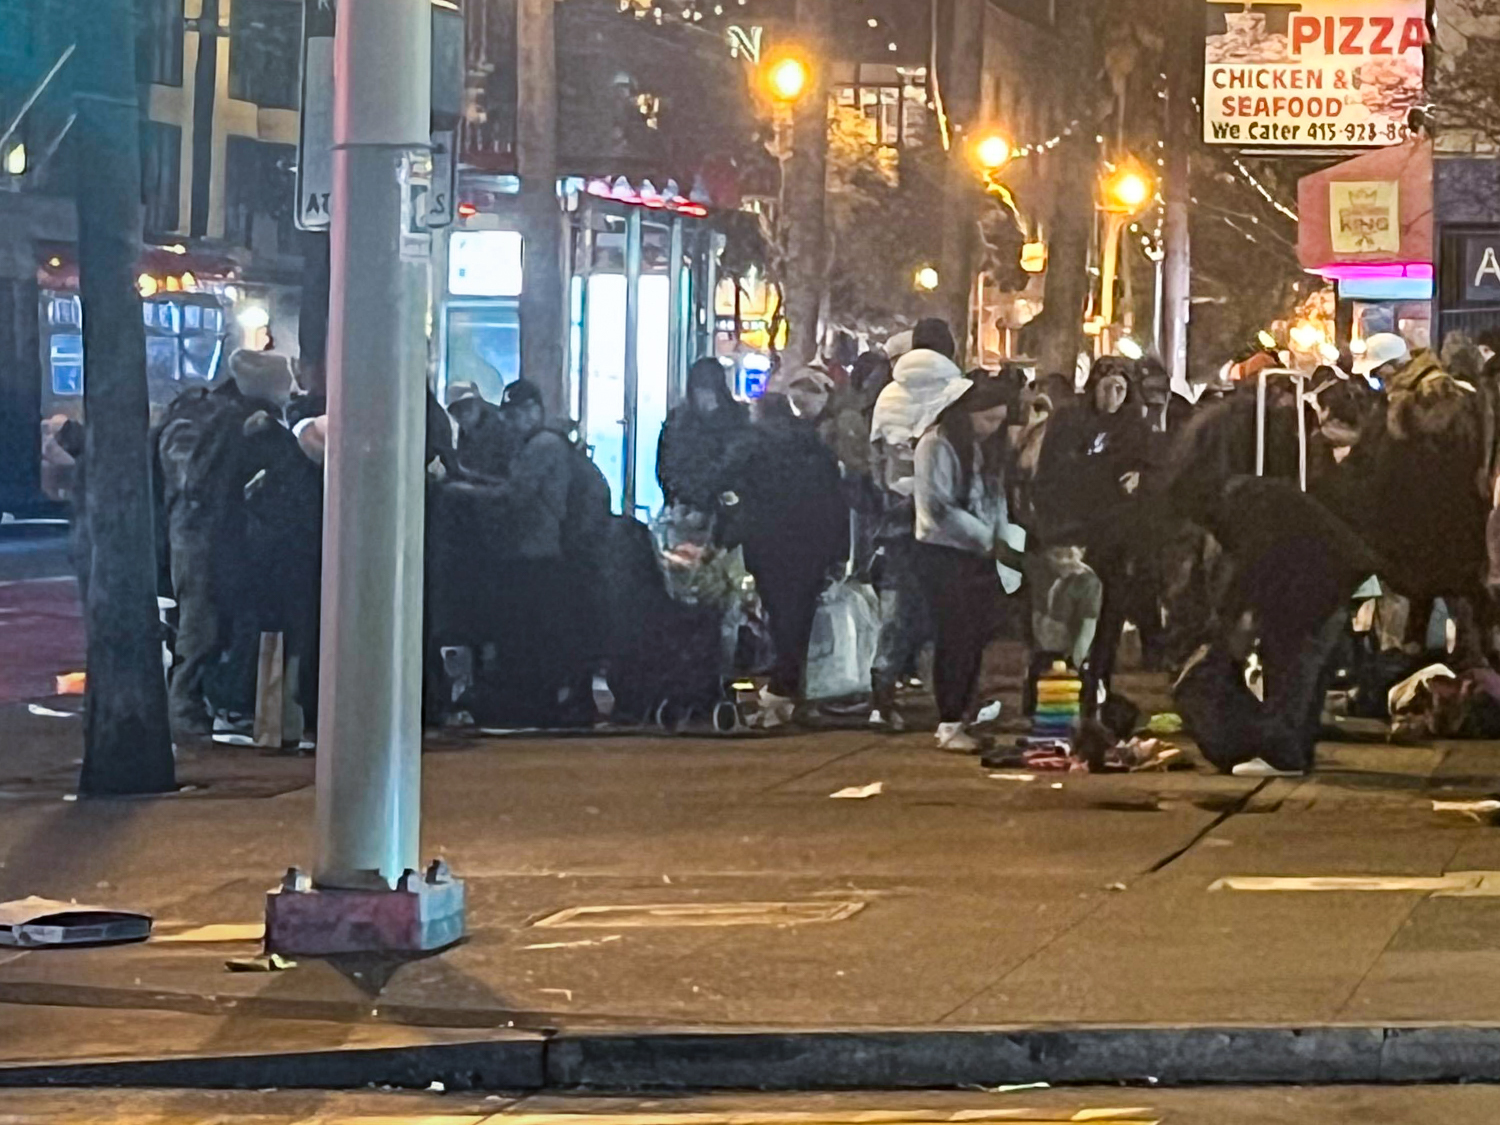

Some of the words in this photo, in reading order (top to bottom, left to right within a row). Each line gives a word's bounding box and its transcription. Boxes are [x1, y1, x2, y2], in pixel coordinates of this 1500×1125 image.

[1292, 16, 1428, 56] PIZZA
[1211, 68, 1323, 90] CHICKEN
[1332, 69, 1348, 90] &
[1221, 95, 1343, 118] SEAFOOD
[1210, 121, 1241, 140] We
[1247, 121, 1301, 141] Cater
